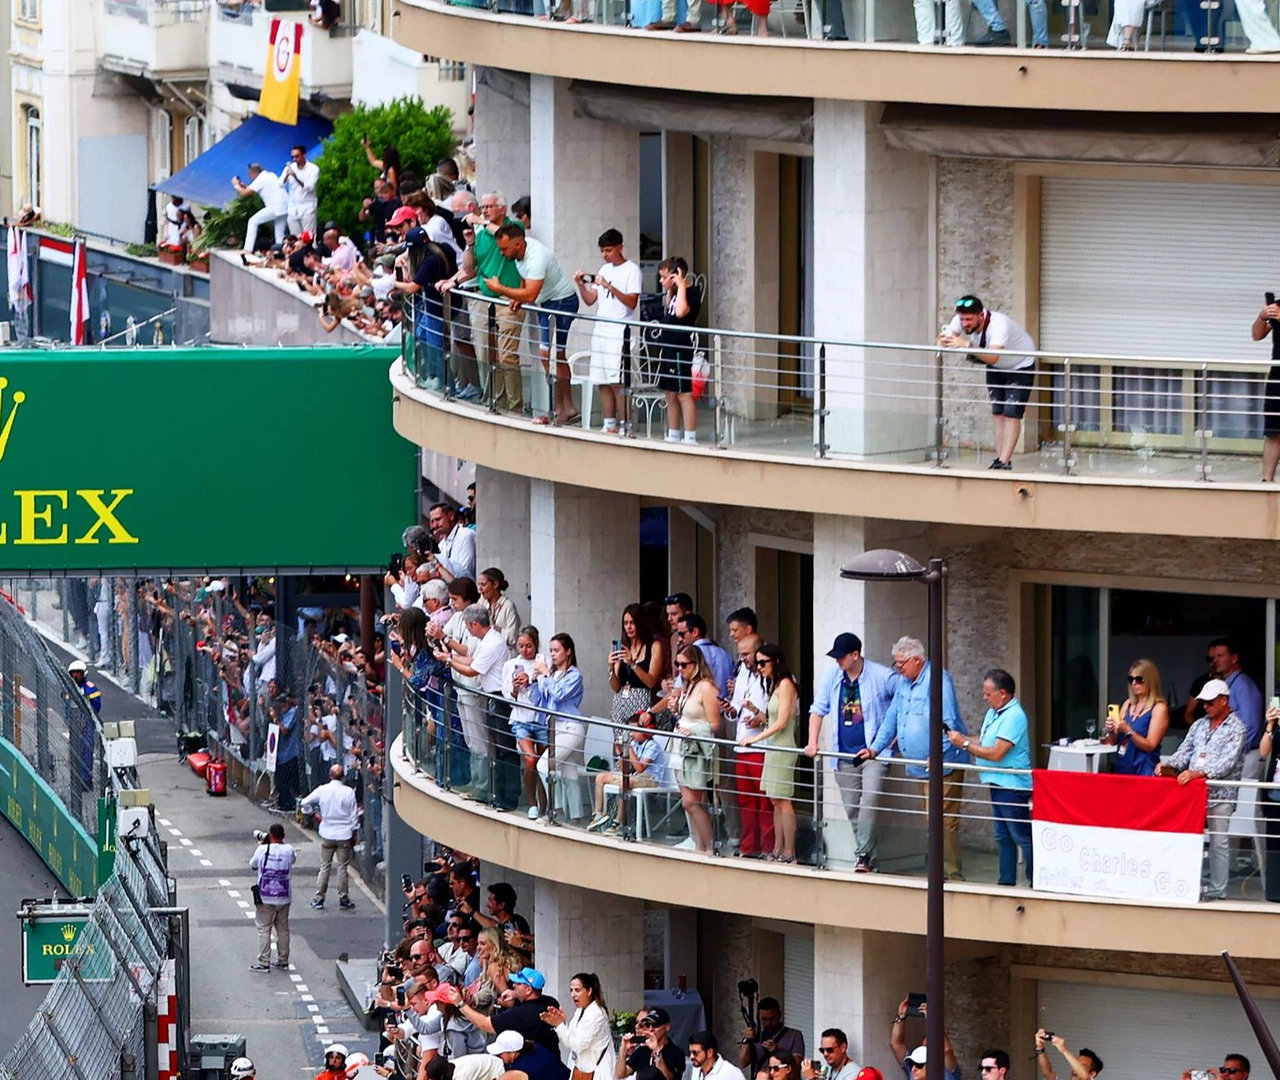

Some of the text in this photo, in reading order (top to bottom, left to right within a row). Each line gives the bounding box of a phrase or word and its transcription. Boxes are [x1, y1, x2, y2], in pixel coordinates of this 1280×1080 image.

[1041, 827, 1073, 853] Go
[1079, 846, 1151, 878] Charles
[1154, 871, 1190, 898] Go
